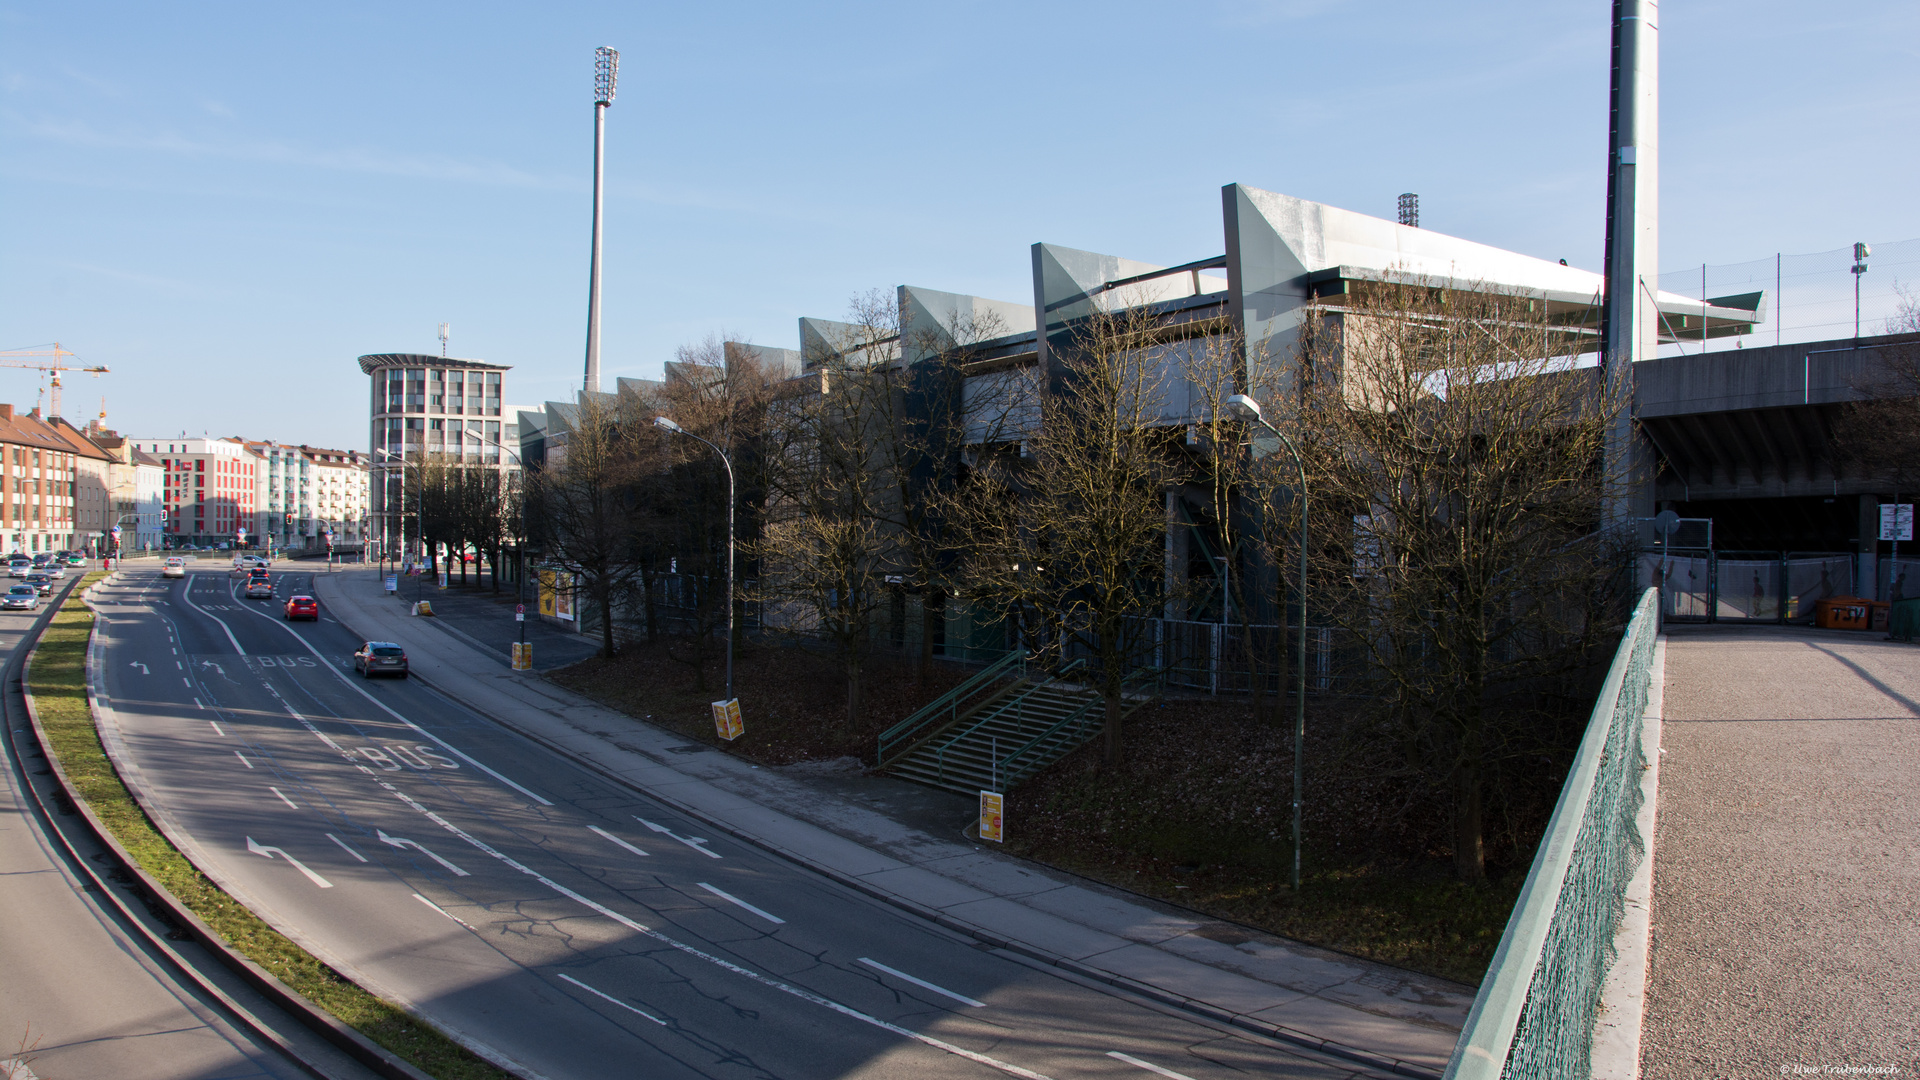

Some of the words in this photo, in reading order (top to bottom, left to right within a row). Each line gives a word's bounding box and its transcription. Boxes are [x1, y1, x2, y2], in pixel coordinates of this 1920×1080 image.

[1830, 607, 1864, 624] TSV
[256, 656, 317, 667] BUS
[355, 745, 460, 772] BUS
